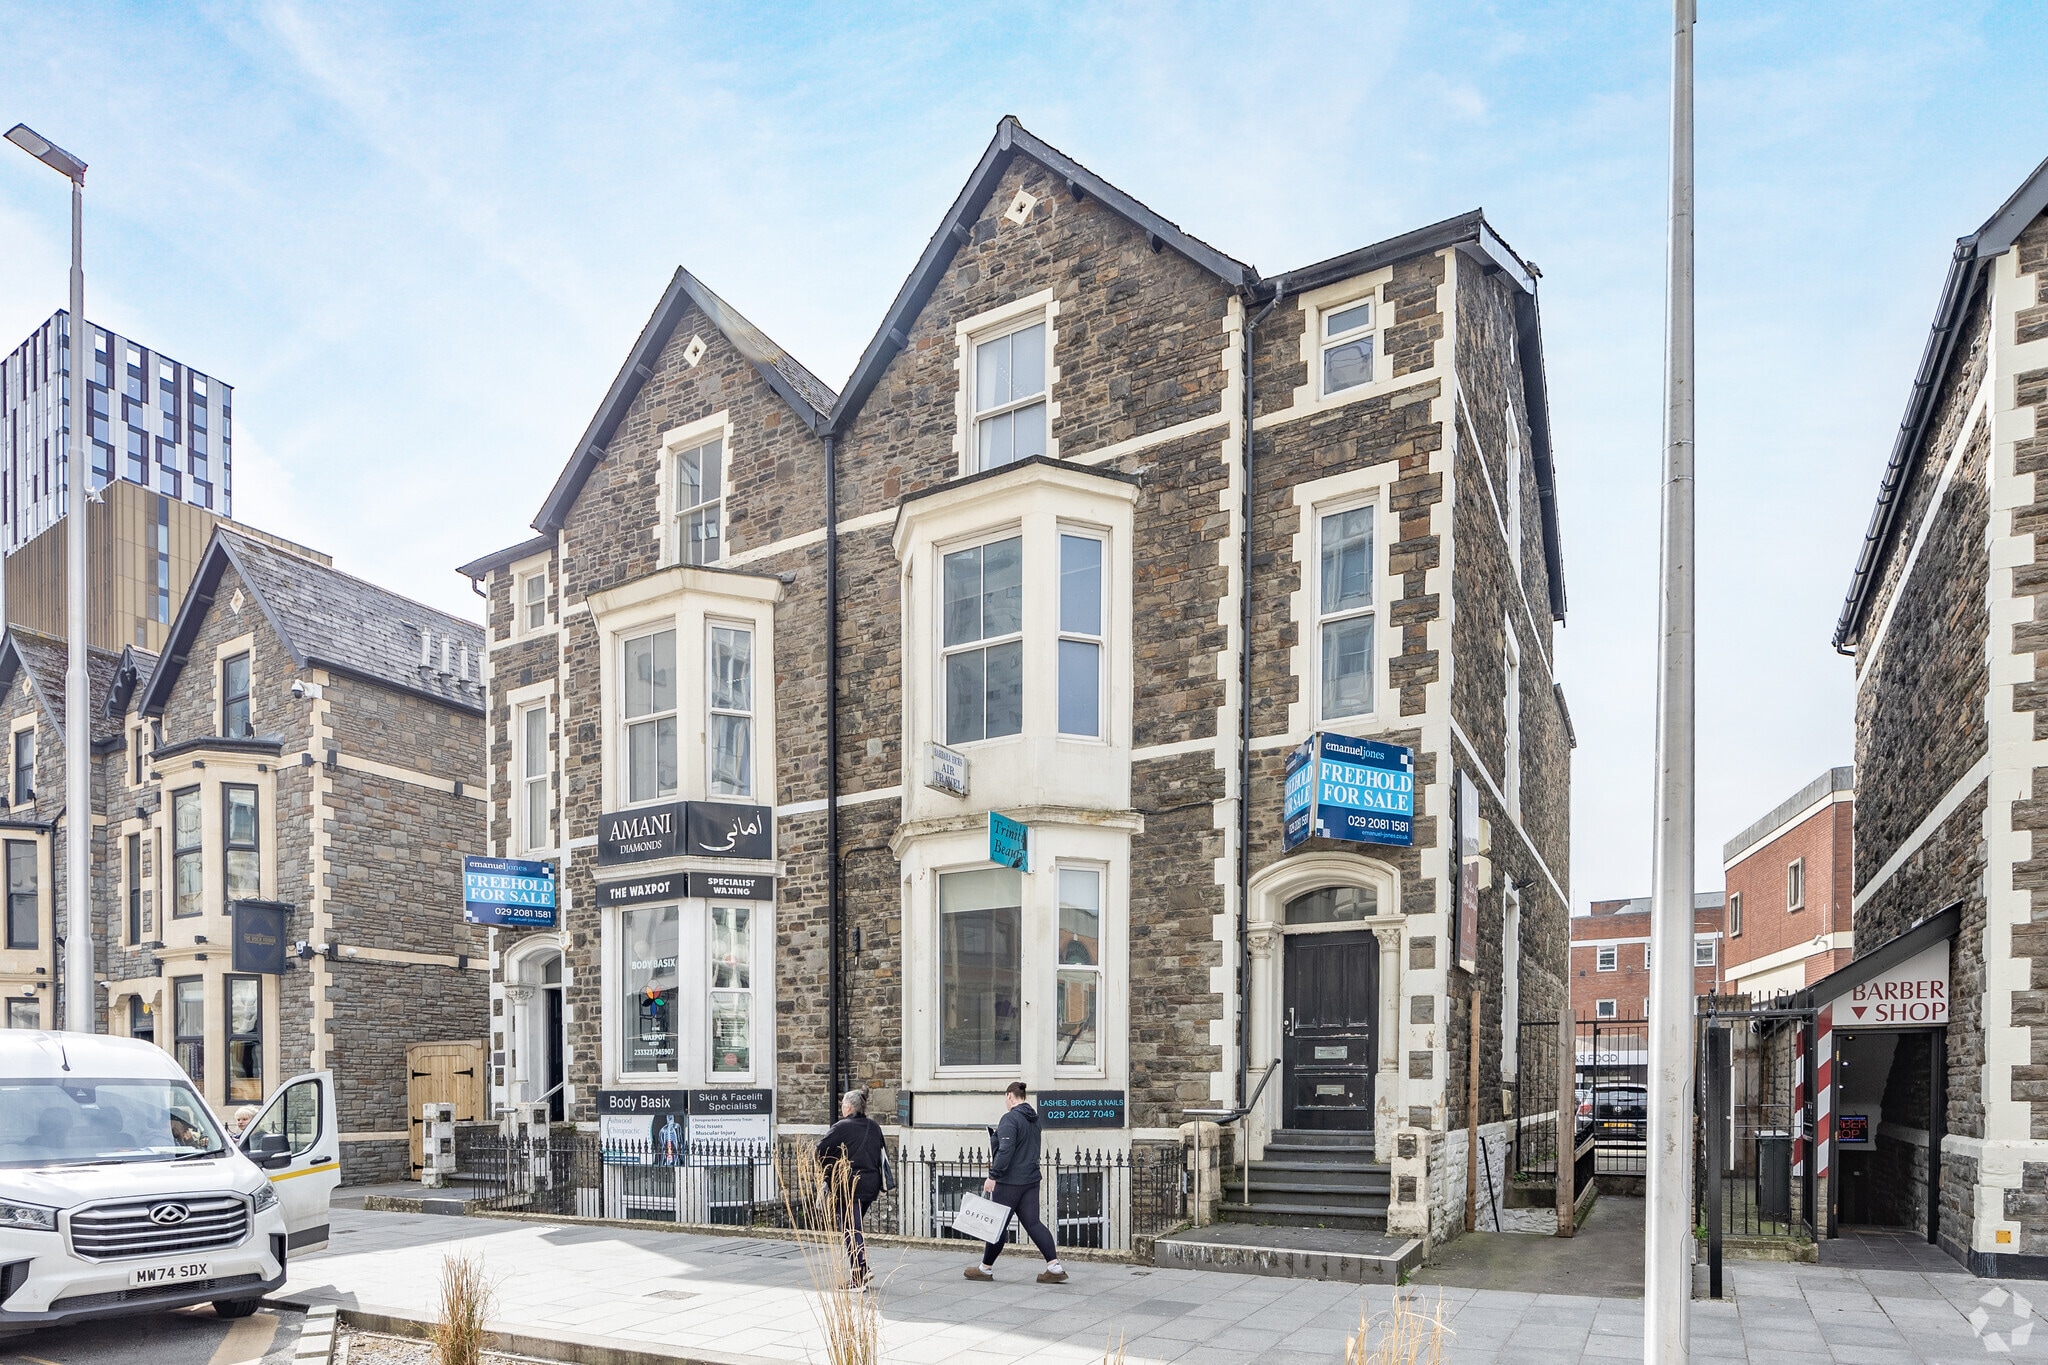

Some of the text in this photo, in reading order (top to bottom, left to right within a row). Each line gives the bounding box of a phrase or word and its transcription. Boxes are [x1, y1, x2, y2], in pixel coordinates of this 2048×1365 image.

[1326, 742, 1385, 760] emanueljones
[942, 762, 955, 776] AIR
[1321, 762, 1412, 793] FREEHOLD
[934, 771, 963, 790] TRAVEL
[1293, 785, 1310, 810] SALE
[1323, 784, 1408, 811] FOR SALE
[609, 813, 672, 842] AMANI
[1348, 815, 1409, 832] 029 2081 1581
[620, 840, 662, 855] DIAMONDS
[994, 839, 1024, 858] Beauty
[470, 861, 527, 872] emanueljones
[467, 874, 554, 892] FREEHOLD
[610, 881, 670, 899] THE WAXPOT
[708, 878, 756, 887] SPECIALIST
[713, 886, 750, 896] WAXING
[471, 888, 551, 905] FOR SALE
[514, 909, 533, 917] 2081
[535, 910, 551, 918] 1581
[632, 958, 676, 970] BODY BASIX
[1852, 980, 1945, 1001] BARBER
[1876, 1002, 1946, 1022] SHOP
[1588, 1054, 1618, 1062] FOOD
[609, 1095, 671, 1111] Body Basix
[698, 1093, 718, 1102] Skin
[709, 1102, 757, 1111] Specialists
[1048, 1110, 1115, 1119] 029 2022 7049
[965, 1209, 994, 1224] OFFICE
[137, 1263, 207, 1282] MW74 SDX
